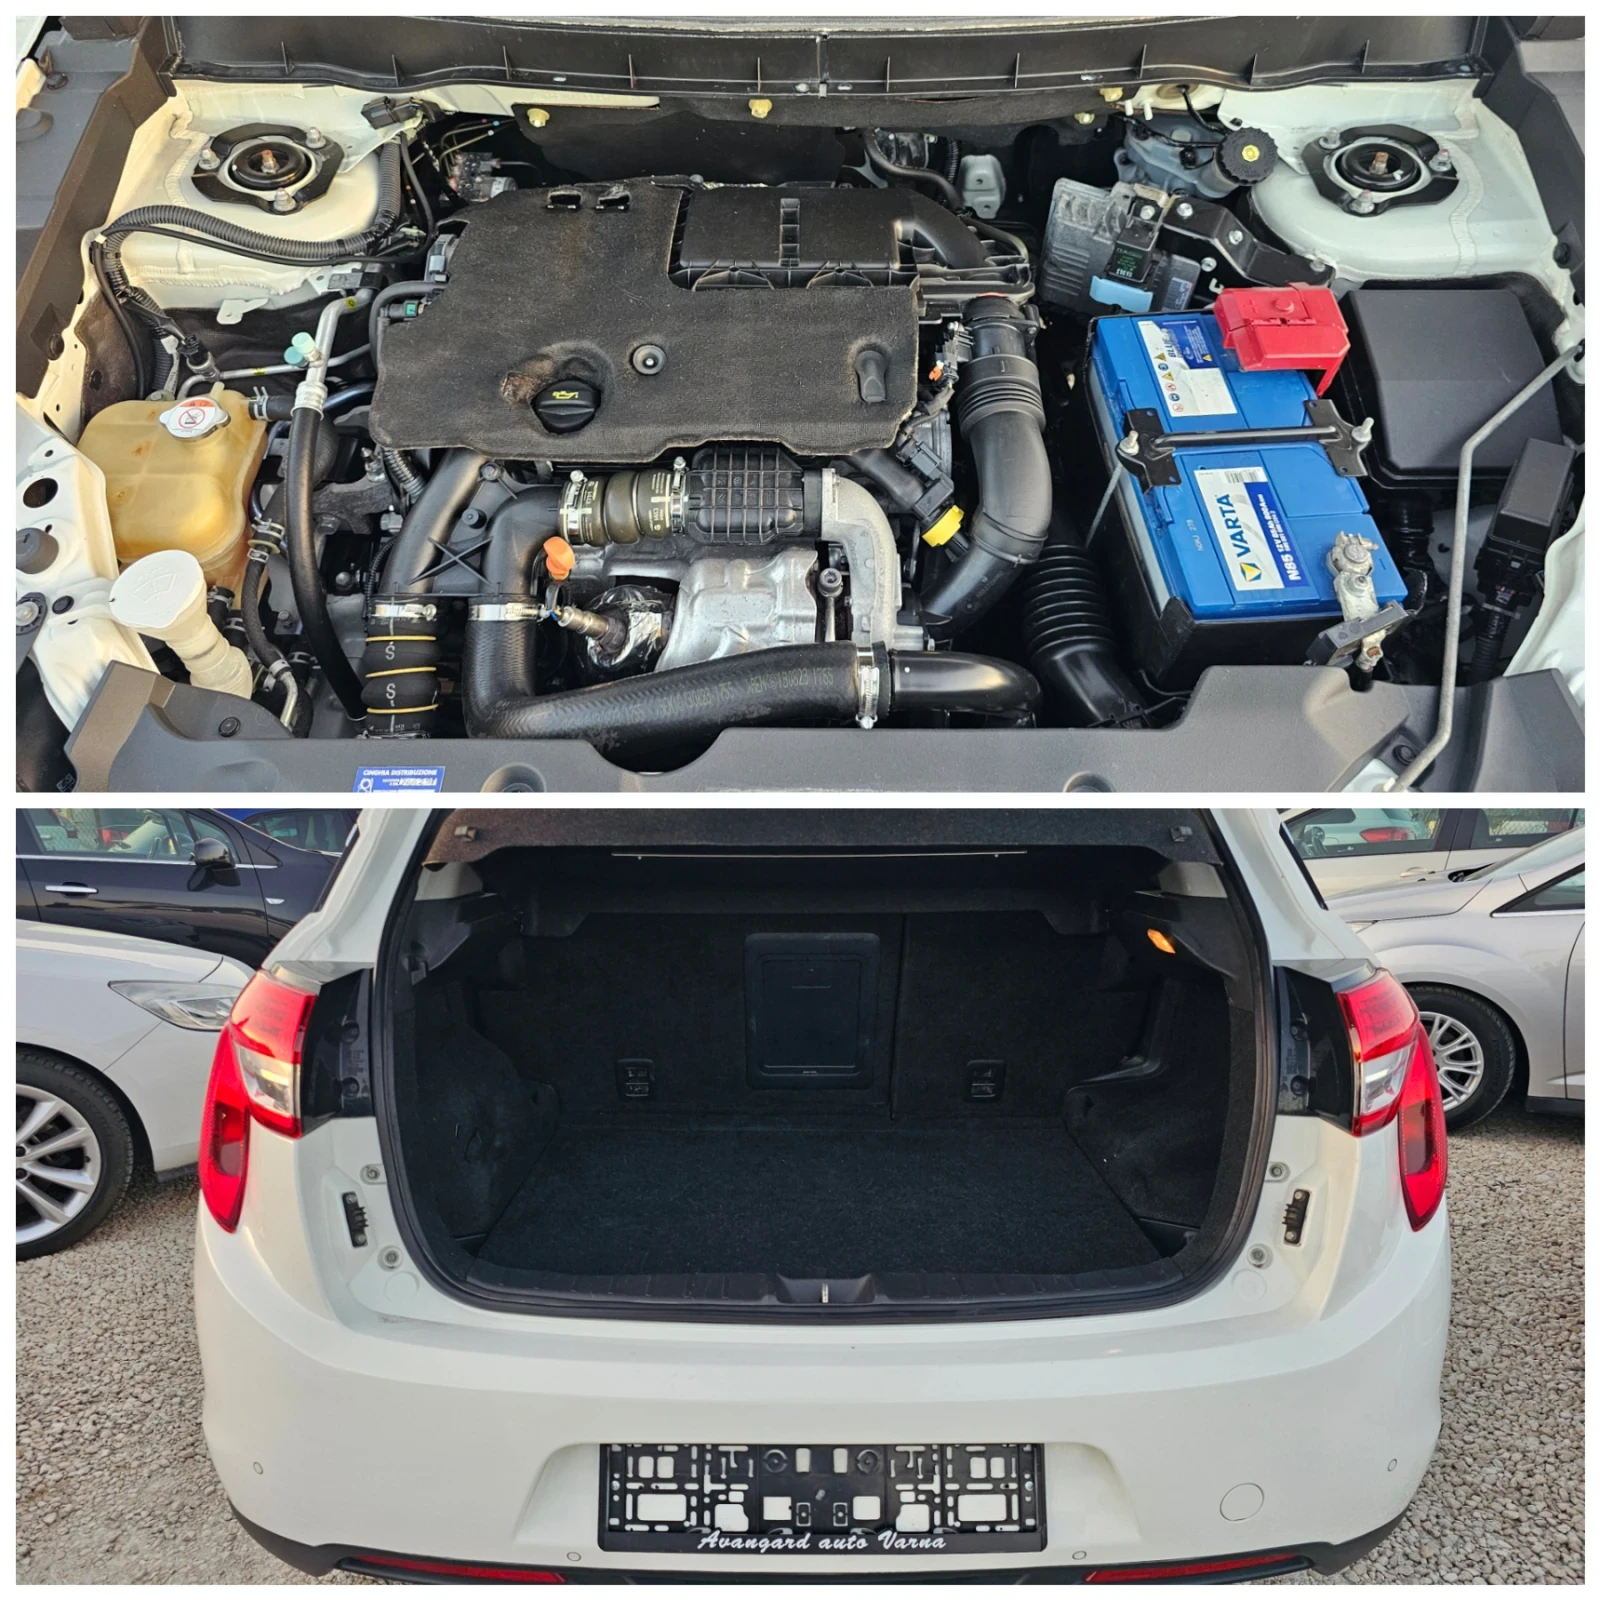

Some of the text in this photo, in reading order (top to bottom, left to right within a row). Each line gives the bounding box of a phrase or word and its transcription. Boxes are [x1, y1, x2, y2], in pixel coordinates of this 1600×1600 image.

[1216, 494, 1251, 558] VARTA
[1281, 554, 1302, 581] N85
[385, 645, 396, 660] S
[386, 683, 396, 699] S
[698, 1530, 947, 1554] Avangard auto Varna
